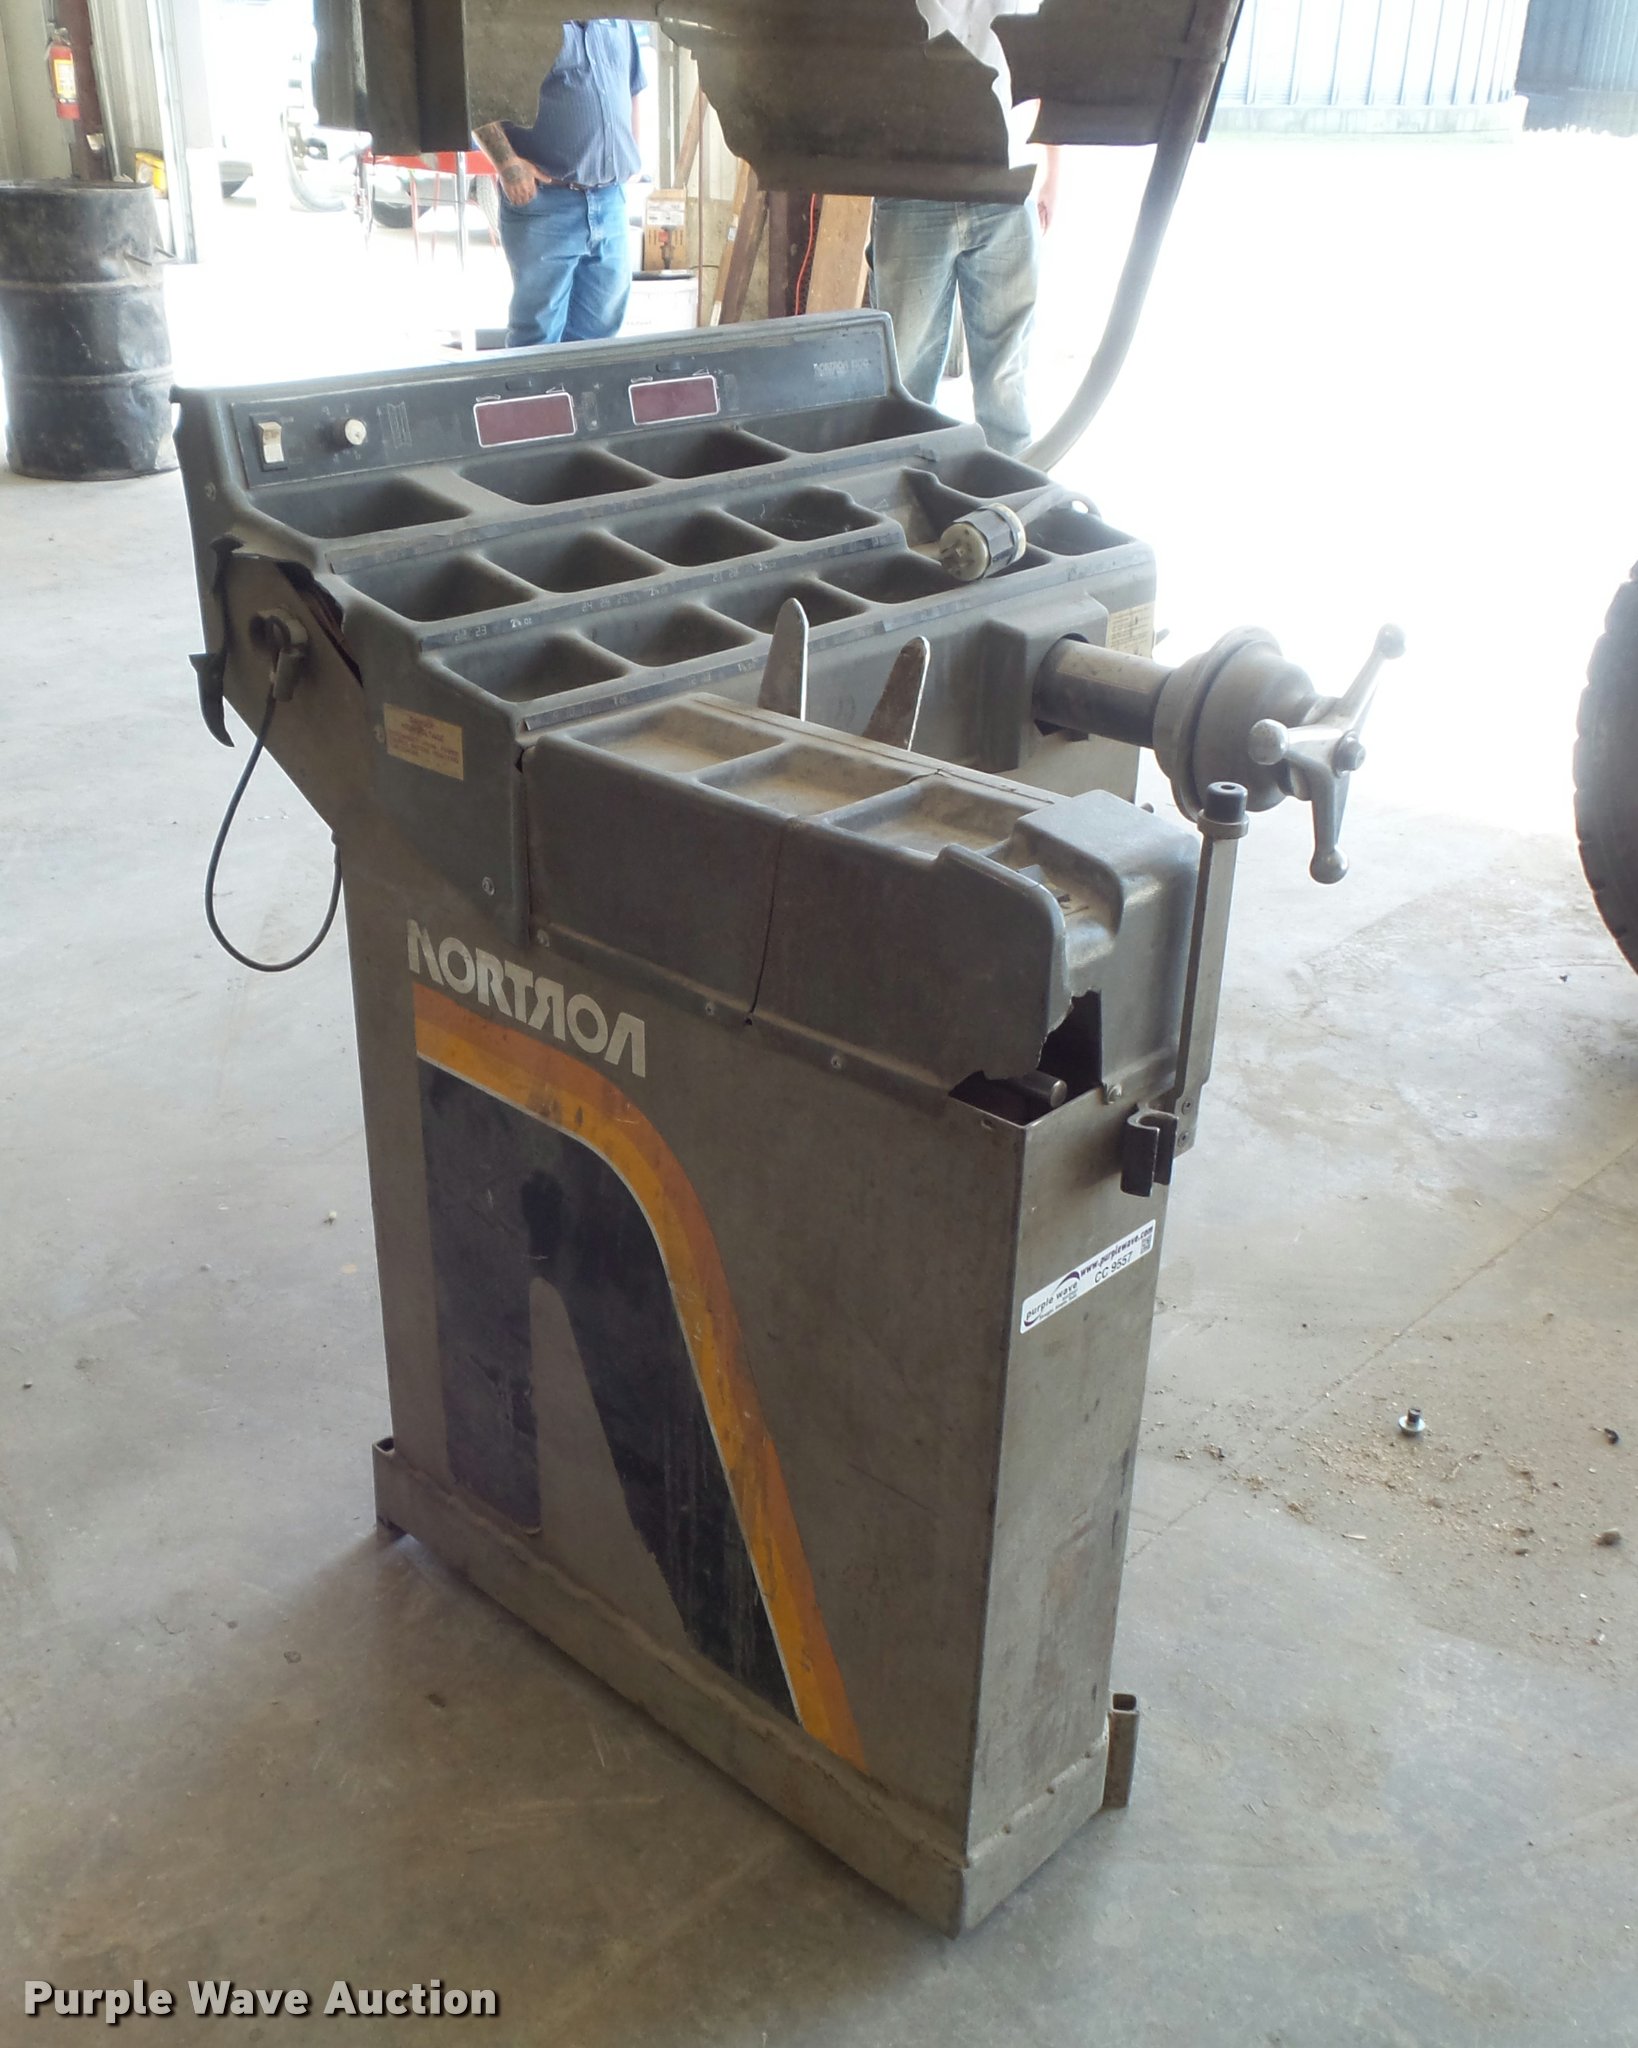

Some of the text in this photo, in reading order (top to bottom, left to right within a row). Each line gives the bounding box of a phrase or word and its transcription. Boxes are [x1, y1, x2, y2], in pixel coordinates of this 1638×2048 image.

[1080, 1226, 1153, 1277] www.purplewave.com
[1094, 1251, 1133, 1283] CC 9557
[1026, 1296, 1054, 1320] purple
[1056, 1281, 1078, 1299] wave
